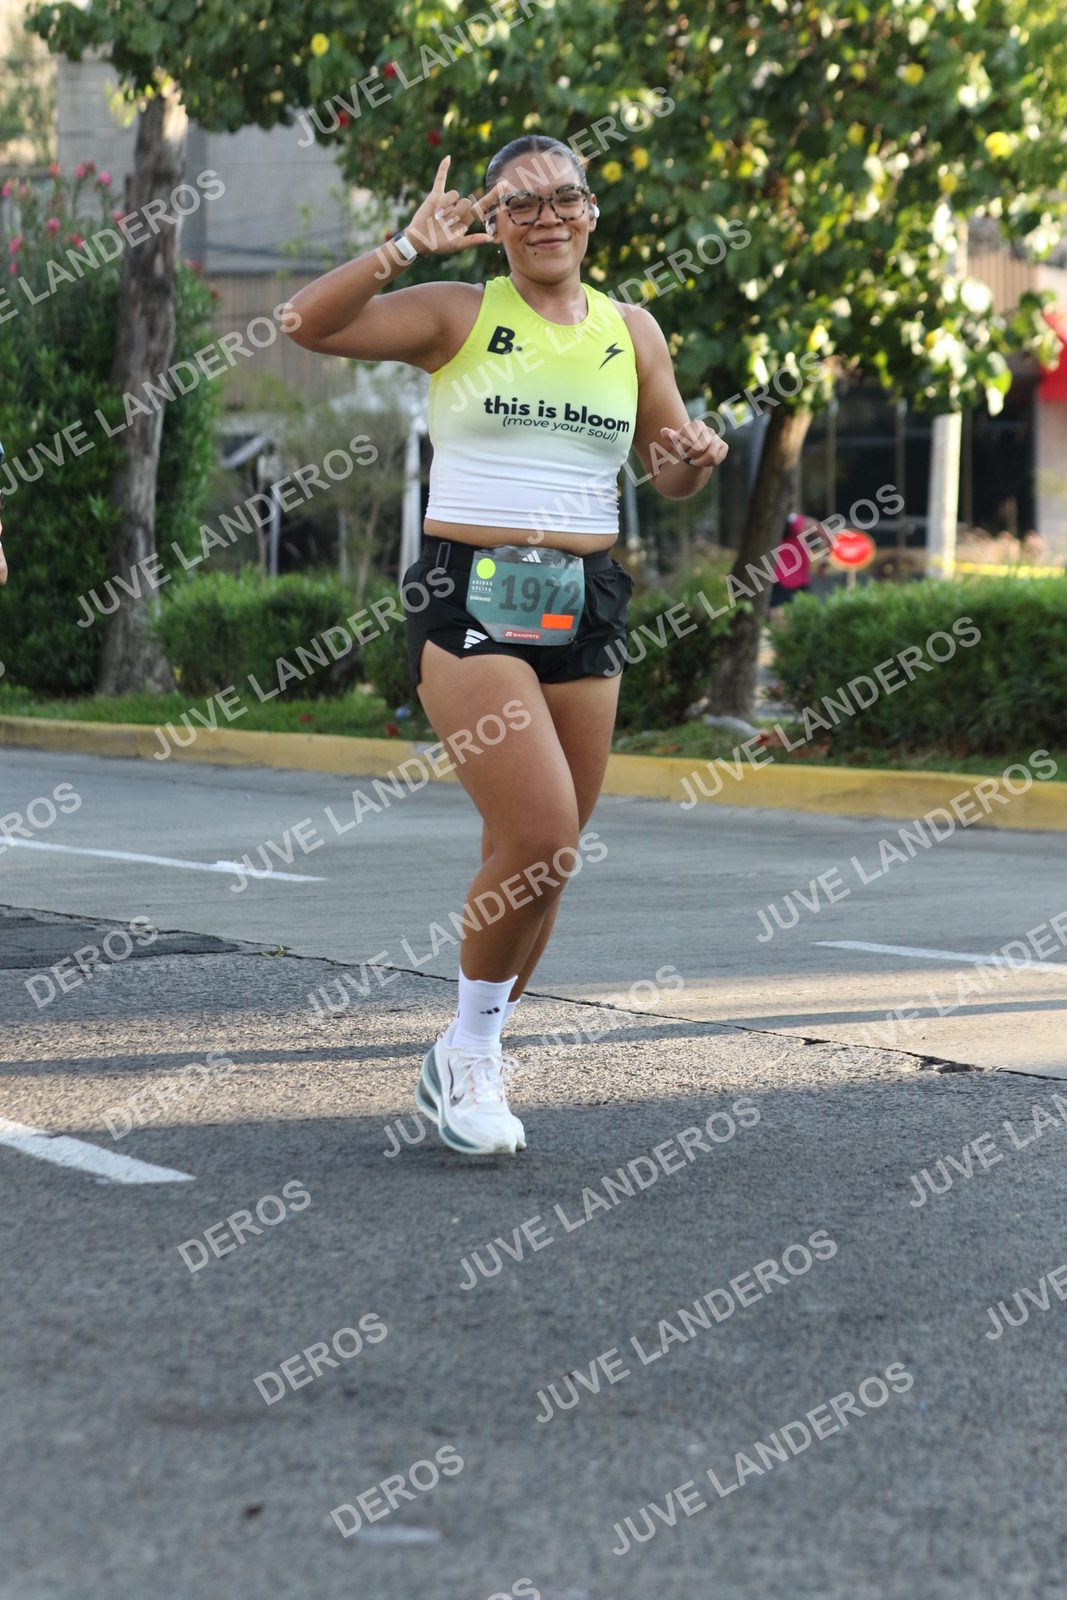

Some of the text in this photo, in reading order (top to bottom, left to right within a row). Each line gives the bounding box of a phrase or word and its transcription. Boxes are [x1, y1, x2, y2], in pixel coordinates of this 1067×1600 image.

[484, 395, 630, 433] this is bloom
[502, 416, 619, 443] (move your soul)
[499, 574, 581, 616] 1972
